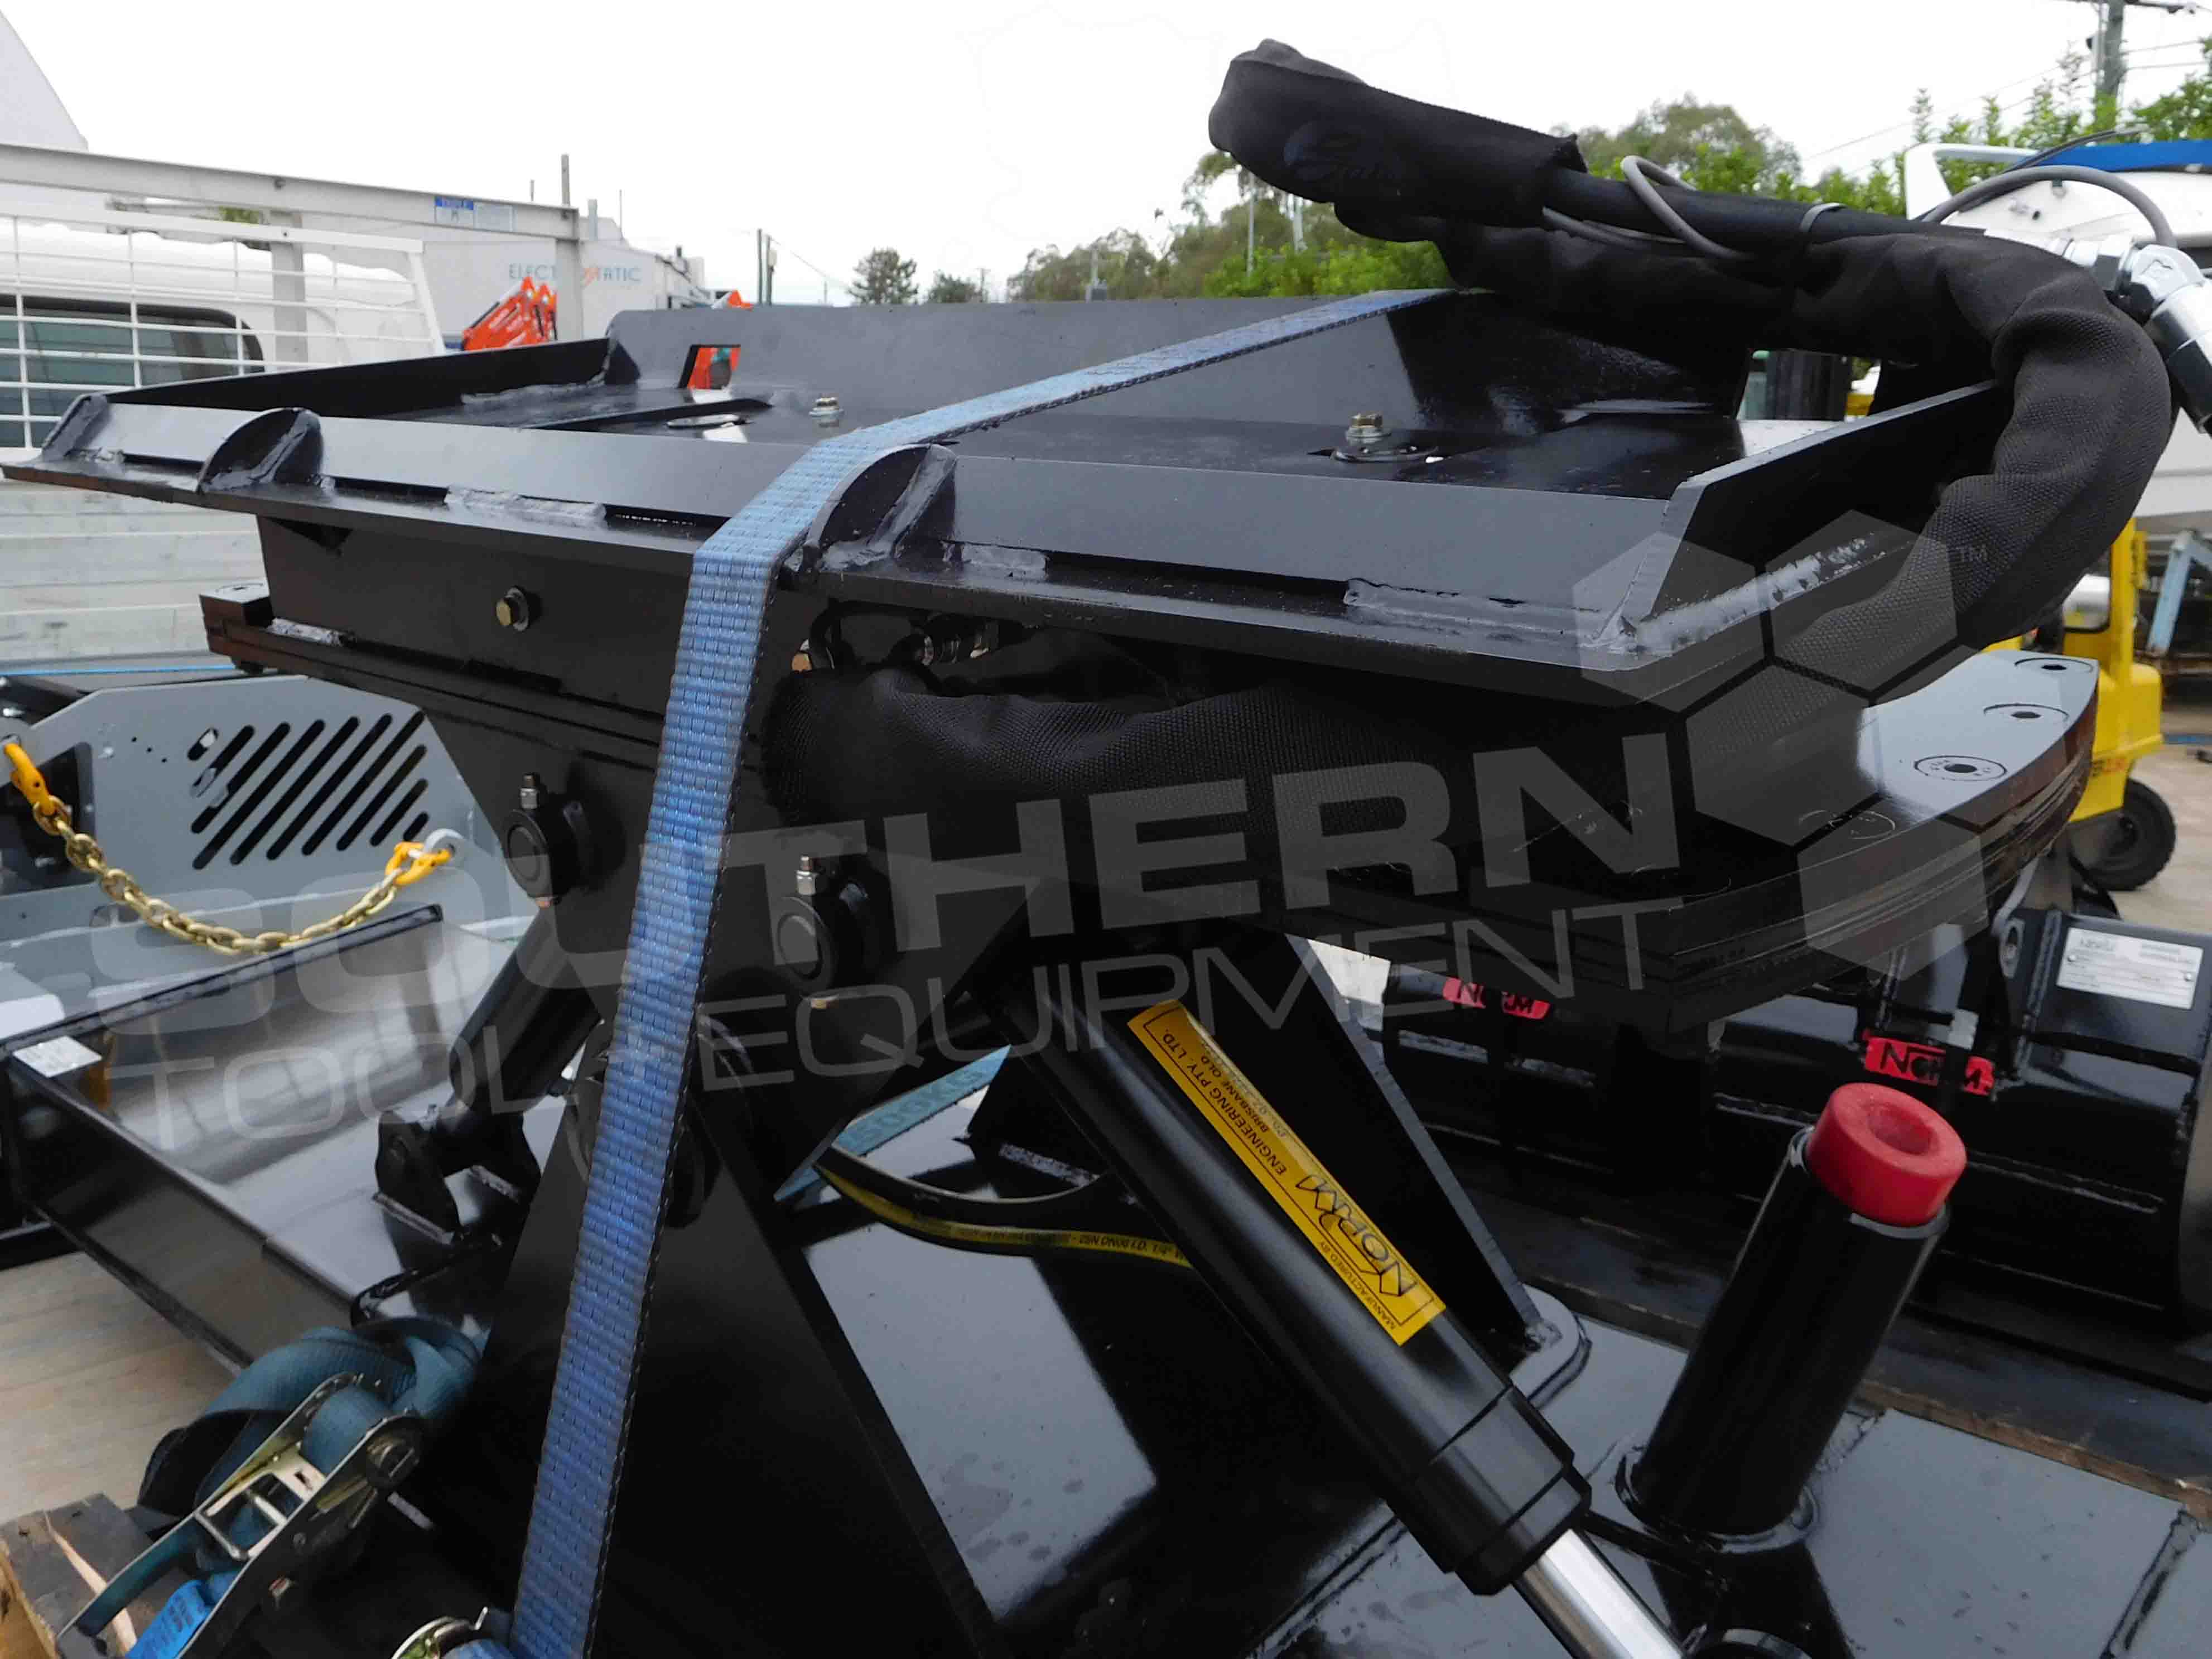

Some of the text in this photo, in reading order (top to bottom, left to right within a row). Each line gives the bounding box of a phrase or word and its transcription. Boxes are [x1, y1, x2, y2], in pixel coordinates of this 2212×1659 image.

[1162, 1028, 1187, 1059] LTD.
[1208, 1087, 1288, 1175] ENGINEERING
[1221, 1080, 1270, 1133] BRISBANE
[1295, 1174, 1420, 1297] NORM
[1320, 1240, 1396, 1330] MANUFACTURED BY
